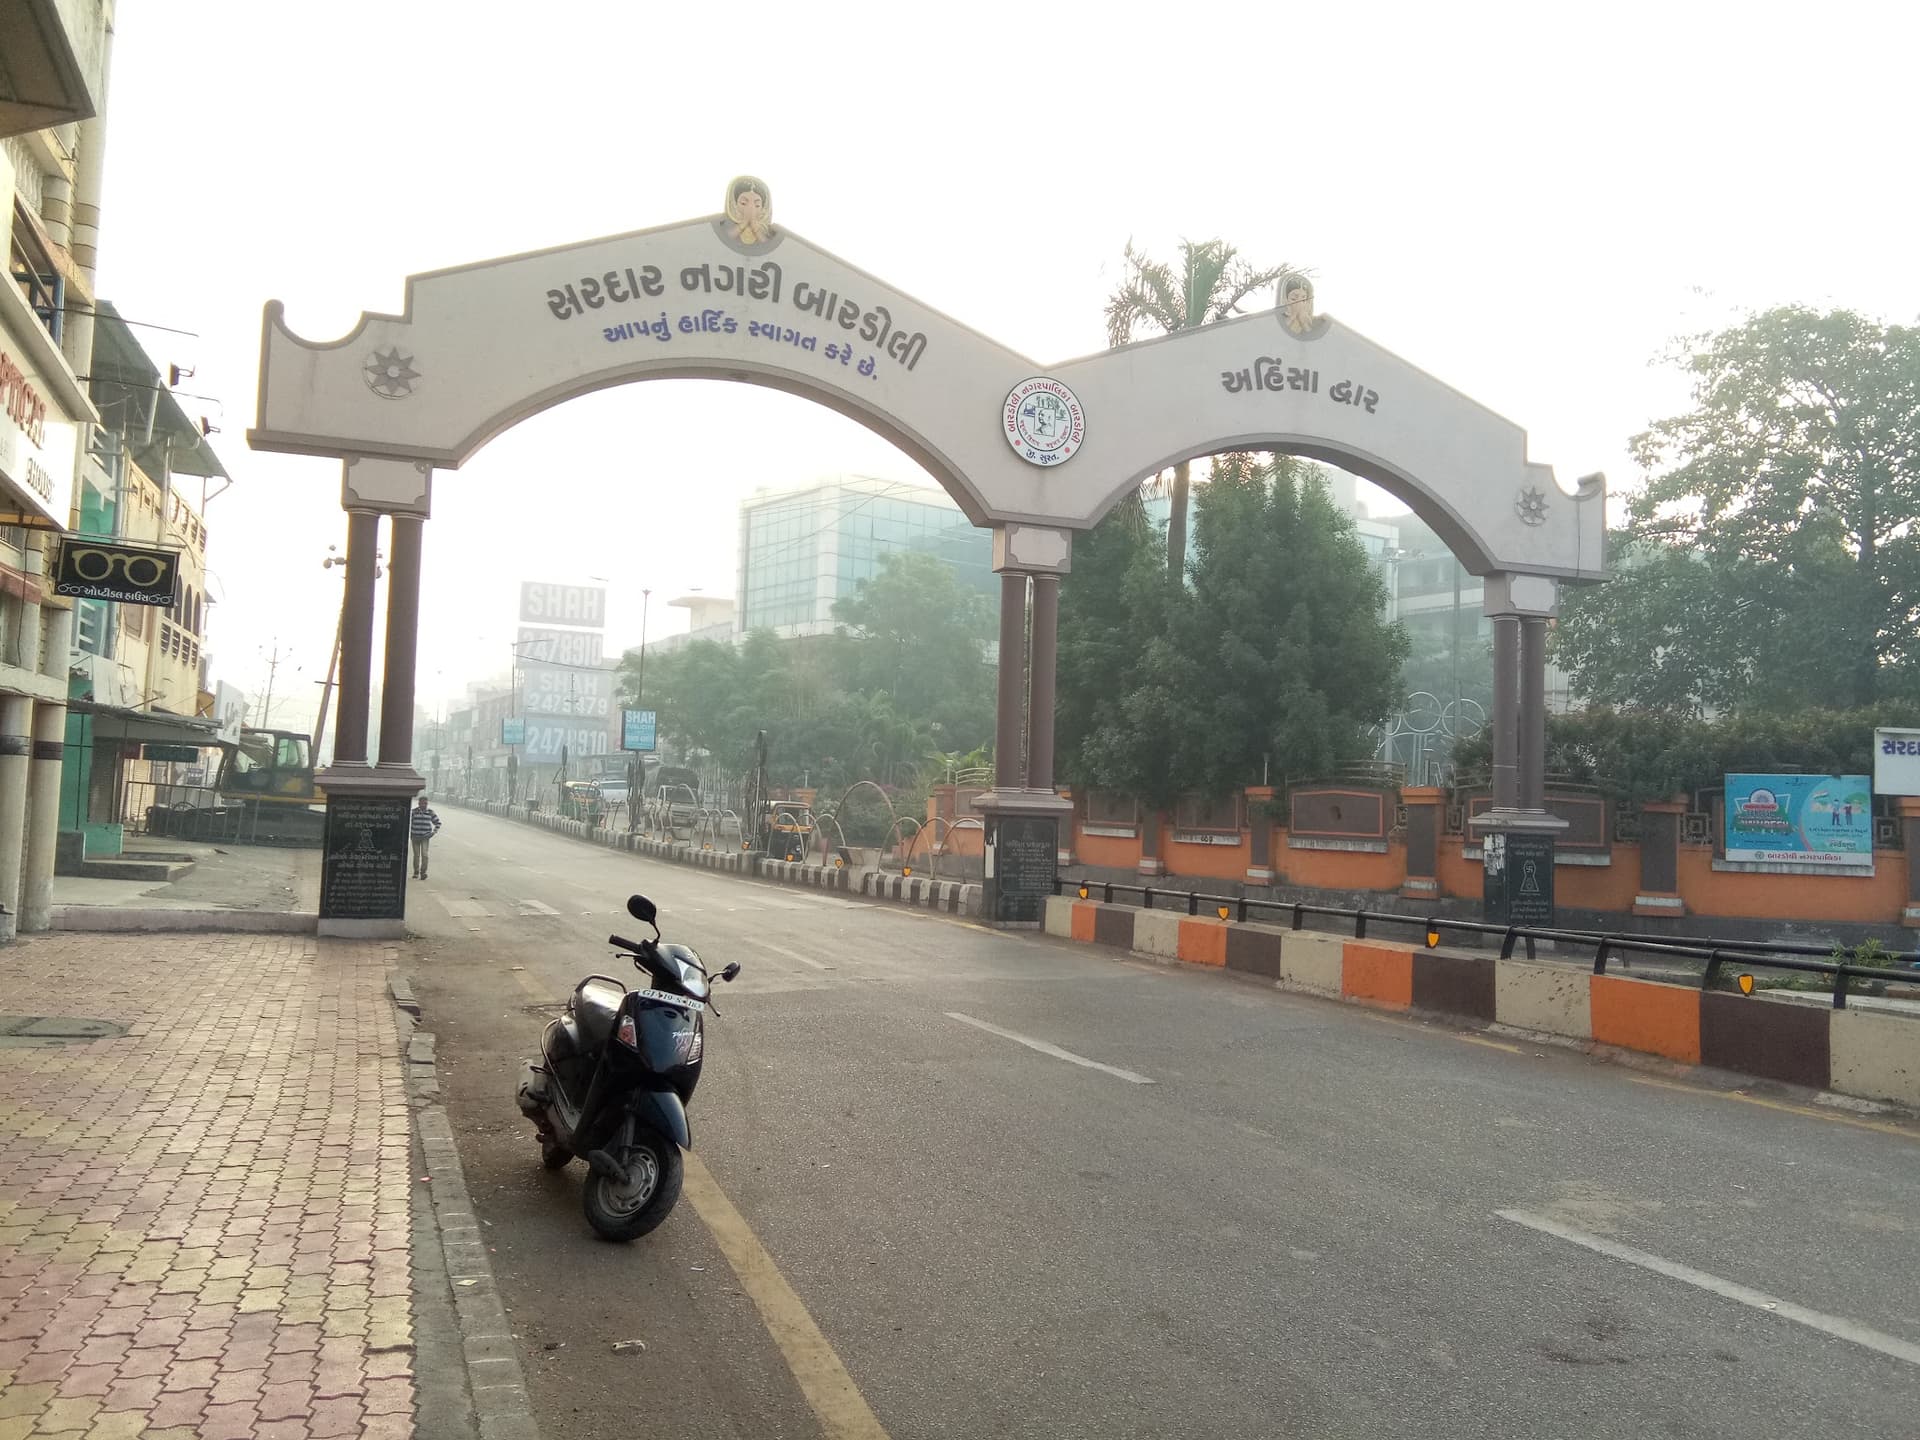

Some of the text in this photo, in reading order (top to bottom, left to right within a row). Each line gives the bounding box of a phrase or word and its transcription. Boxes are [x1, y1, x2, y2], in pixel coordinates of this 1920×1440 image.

[547, 261, 928, 372] સરદાર નગરી બારડોલી
[603, 309, 878, 381] આપનું હાર્દિક સ્વાગત કરે છે.
[1221, 355, 1380, 415] અહિંસા દ્વાર
[84, 586, 123, 599] ઓપ્ટીકલ
[527, 583, 599, 620] SHAH
[540, 672, 599, 695] SHAH
[625, 711, 656, 724] SHAH
